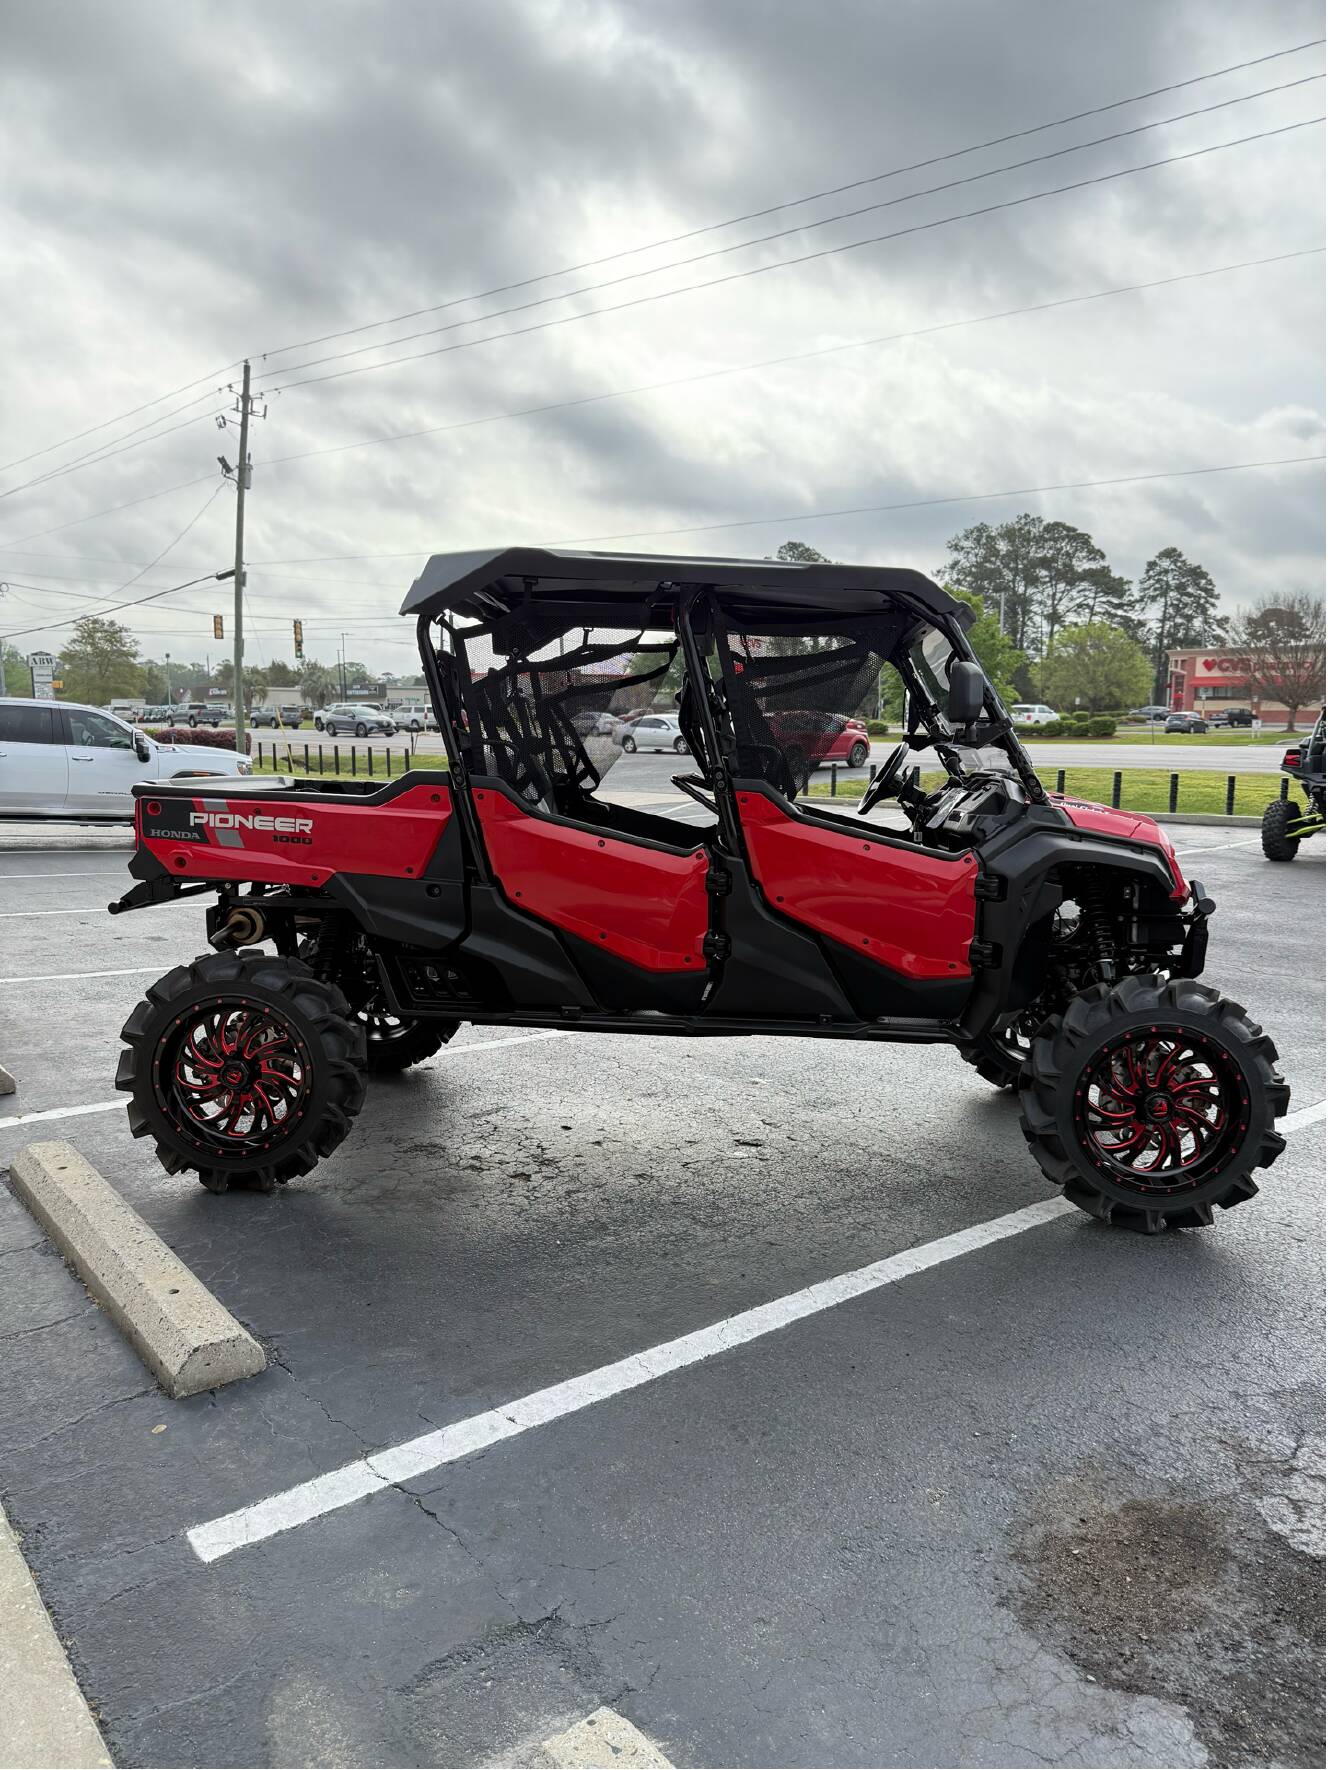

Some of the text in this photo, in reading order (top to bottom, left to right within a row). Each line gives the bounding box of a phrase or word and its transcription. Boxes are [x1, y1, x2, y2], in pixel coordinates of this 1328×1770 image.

[190, 812, 313, 834] PIONEER
[151, 829, 200, 840] HONDA
[273, 835, 312, 844] 1000
